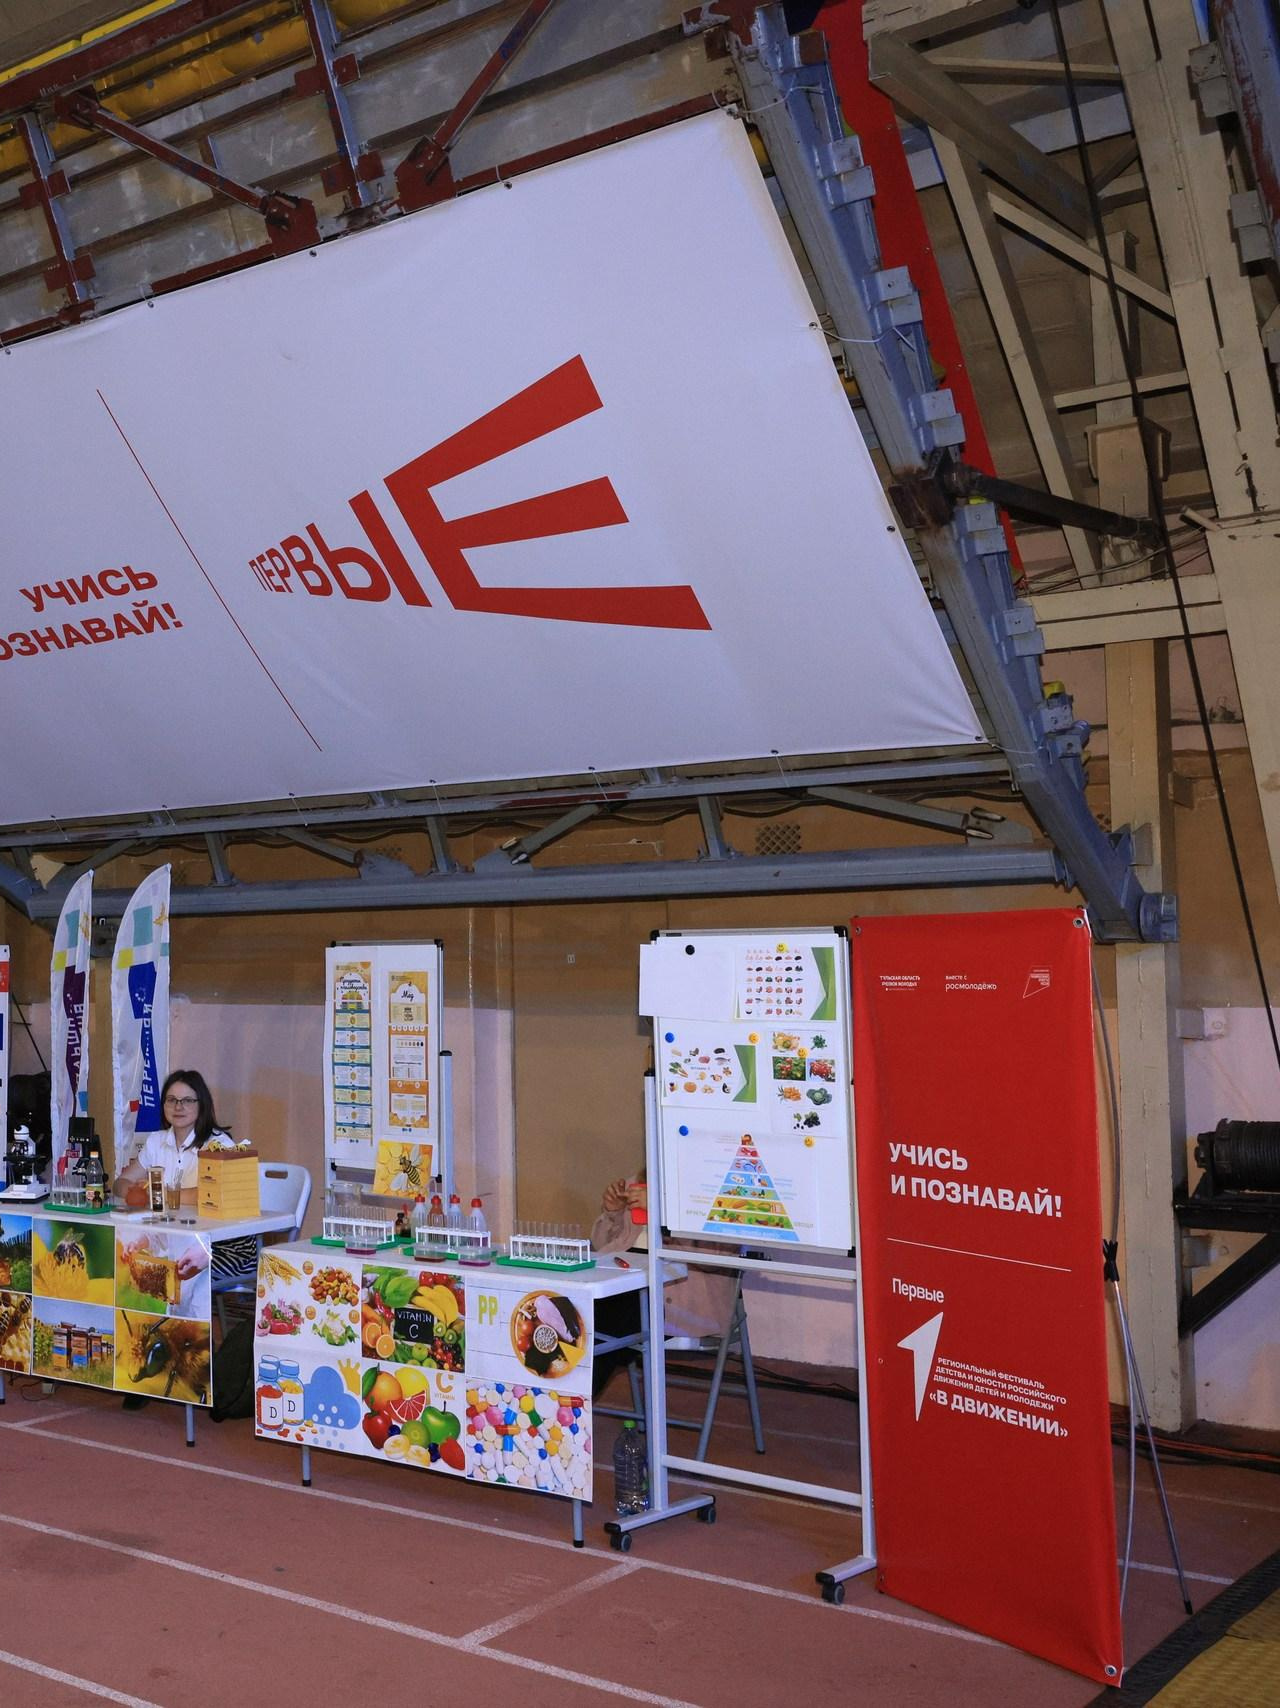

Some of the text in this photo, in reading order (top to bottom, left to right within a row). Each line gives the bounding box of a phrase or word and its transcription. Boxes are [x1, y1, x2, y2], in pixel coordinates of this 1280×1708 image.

[248, 354, 712, 630] ПЕРВЫЕ
[20, 565, 160, 613] УЧИСЬ
[889, 1142, 968, 1171] УЧИСЬ
[891, 1175, 1062, 1218] И ПОЗНАВАЙ!
[892, 1278, 945, 1303] Первые
[409, 1324, 419, 1339] C
[936, 1366, 1067, 1405] ДЕТСТВА И ЮНОСТИ РОССИЙСКОГО
[938, 1357, 1045, 1390] РЕГИОНАЛЬНЫЙ ФЕСТИВАЛЬ
[288, 1400, 296, 1412] D
[933, 1375, 974, 1390] ДВИЖЕНИЯ
[974, 1385, 1000, 1398] ДЕТЕЙ
[1006, 1393, 1054, 1411] МОЛОДЕЖИ
[270, 1407, 277, 1418] D
[929, 1389, 1068, 1437] «В ДВИЖЕНИИ»
